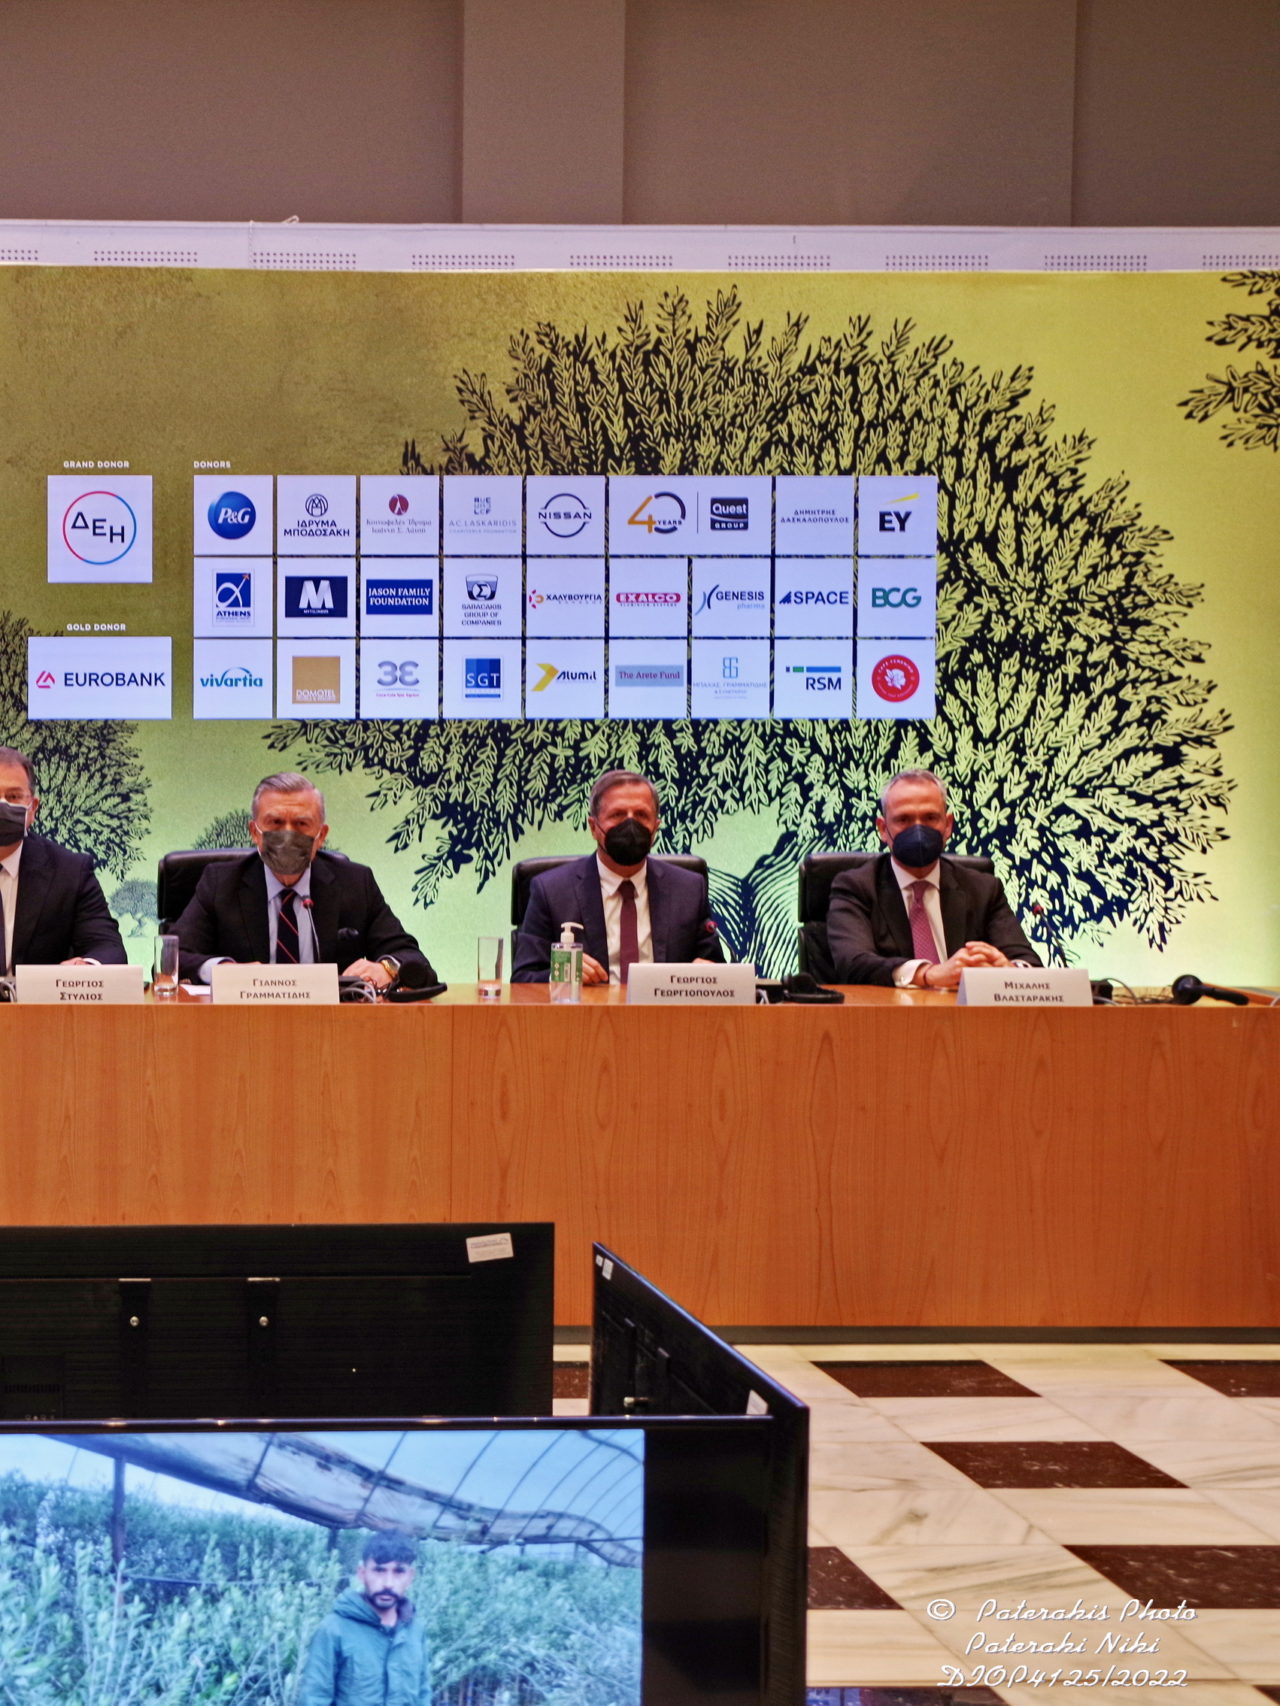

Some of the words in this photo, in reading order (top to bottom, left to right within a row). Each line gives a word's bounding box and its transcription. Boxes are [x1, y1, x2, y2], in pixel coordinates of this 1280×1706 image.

[63, 461, 95, 469] GRAND
[97, 461, 130, 469] DONOR
[193, 461, 231, 469] DONORS
[712, 503, 747, 514] Quest
[218, 507, 251, 525] P&G
[538, 511, 592, 520] NISSAN
[297, 519, 337, 528] ΙΔΡΥΜΑ
[878, 511, 912, 532] EY
[70, 511, 125, 544] ΔΕΗ
[283, 528, 350, 537] ΜΠΟΔΟΣΑΚΗ
[368, 587, 396, 597] JASON
[398, 587, 431, 596] FAMILY
[715, 591, 765, 601] GENESIS
[370, 597, 429, 606] FOUNDATION
[619, 593, 677, 603] EXALCO
[793, 591, 849, 605] SPACE
[872, 587, 922, 609] BCG
[66, 623, 92, 631] GOLD
[94, 623, 126, 631] DONOR
[200, 666, 263, 688] vivartia
[556, 670, 597, 681] Alumil
[619, 670, 633, 679] The
[635, 670, 658, 679] Arete
[660, 670, 681, 679] Fund
[63, 672, 166, 687] EUROBANK
[466, 672, 500, 687] SGT
[805, 677, 842, 691] RSM
[56, 979, 104, 988] ΓΕΩΡΓΙΟΣ
[253, 979, 297, 987] ΓΙΑΝΝΟΣ
[670, 975, 718, 984] ΓΕΩΡΓΙΟΣ
[1004, 981, 1050, 990] ΜΙΧΑΛΗΣ
[60, 992, 104, 1001] ΣΤΥΛΙΟΣ
[240, 991, 311, 999] ΓΡΑΜΜΑΤΙΔΗΣ
